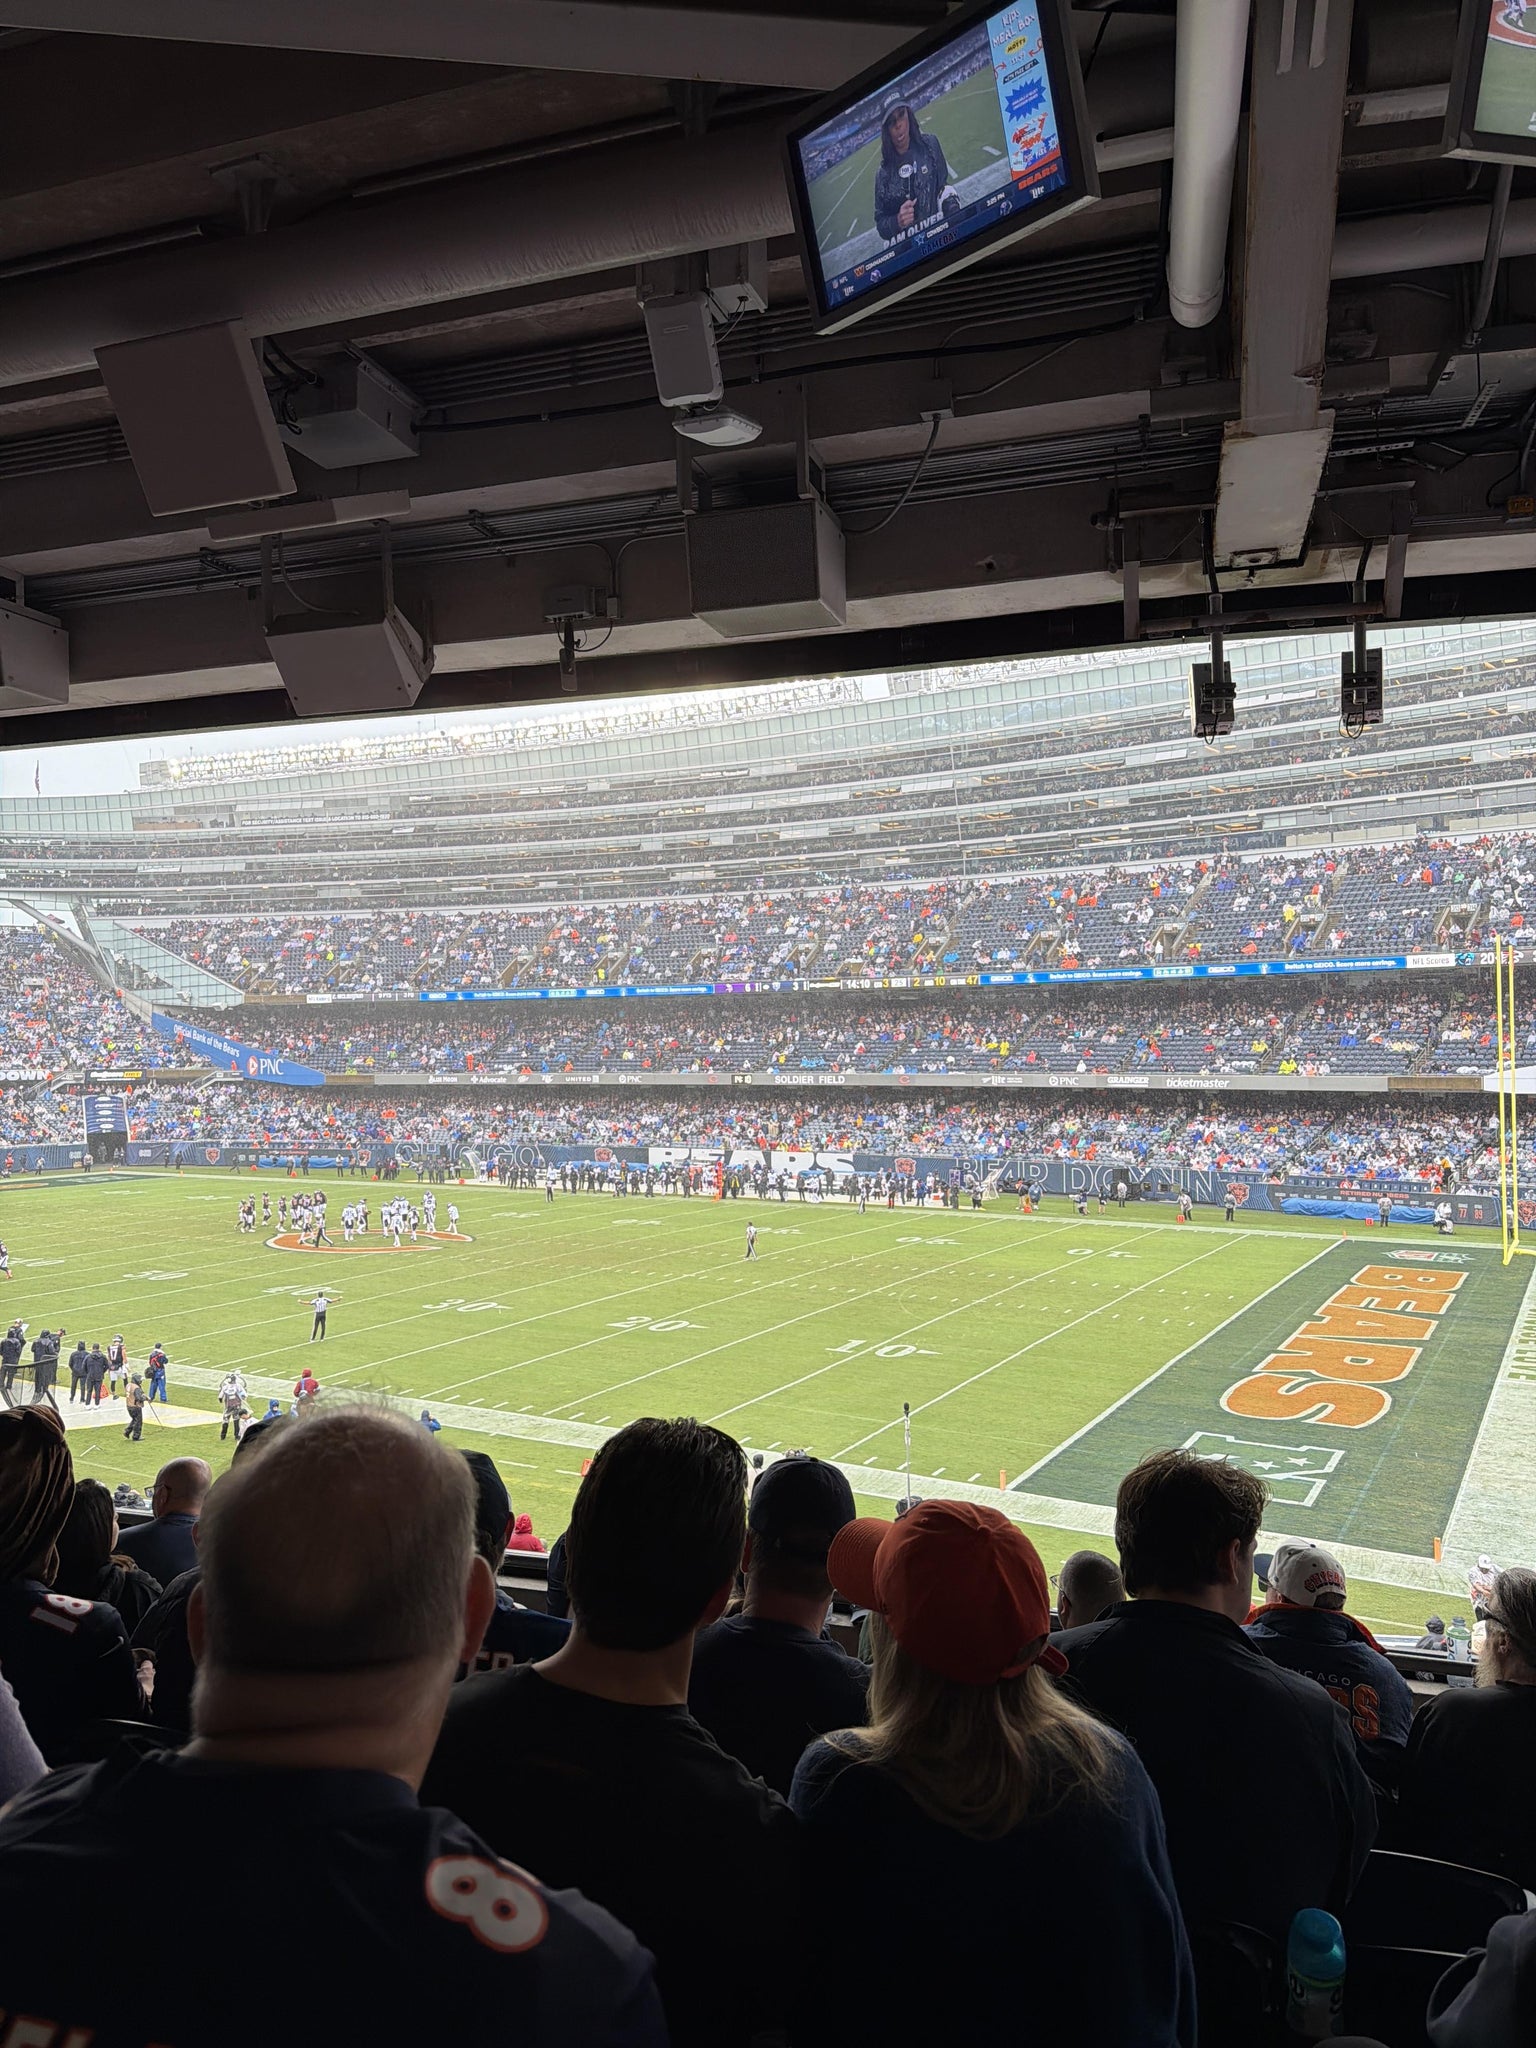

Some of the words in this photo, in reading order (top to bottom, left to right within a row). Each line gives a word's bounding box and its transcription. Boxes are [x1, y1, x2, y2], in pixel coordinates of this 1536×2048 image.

[1018, 164, 1058, 190] BEARS
[907, 212, 944, 236] OLIVER
[927, 222, 949, 238] COWBOYS
[865, 251, 896, 271] COMMANDERS
[1412, 957, 1424, 965] NFL
[1426, 956, 1449, 965] Scores
[1480, 952, 1493, 964] 20
[745, 984, 751, 992] 6
[792, 982, 799, 991] 3
[846, 979, 870, 989] 14:10
[882, 979, 889, 988] 3
[913, 977, 920, 987] 2
[934, 976, 945, 986] 10
[966, 975, 978, 985] 47
[173, 1024, 191, 1037] Official
[193, 1030, 206, 1043] Bank
[206, 1036, 213, 1045] of
[213, 1038, 222, 1048] the
[223, 1042, 240, 1057] Bears
[260, 1058, 284, 1075] PNC
[627, 1075, 642, 1083] PNC
[774, 1076, 814, 1084] SOLDIER
[819, 1076, 845, 1084] FIELD
[1060, 1077, 1079, 1086] PNC
[1107, 1076, 1149, 1085] GRAINGER
[1166, 1076, 1229, 1088] ticketmaster
[1458, 1208, 1467, 1218] 77
[1474, 1208, 1483, 1219] 89
[422, 1298, 499, 1312] 30
[607, 1315, 692, 1333] 20
[825, 1339, 919, 1359] 10
[1219, 1265, 1470, 1430] BEARS
[30, 1593, 94, 1634] 18
[425, 1854, 549, 1953] 8
